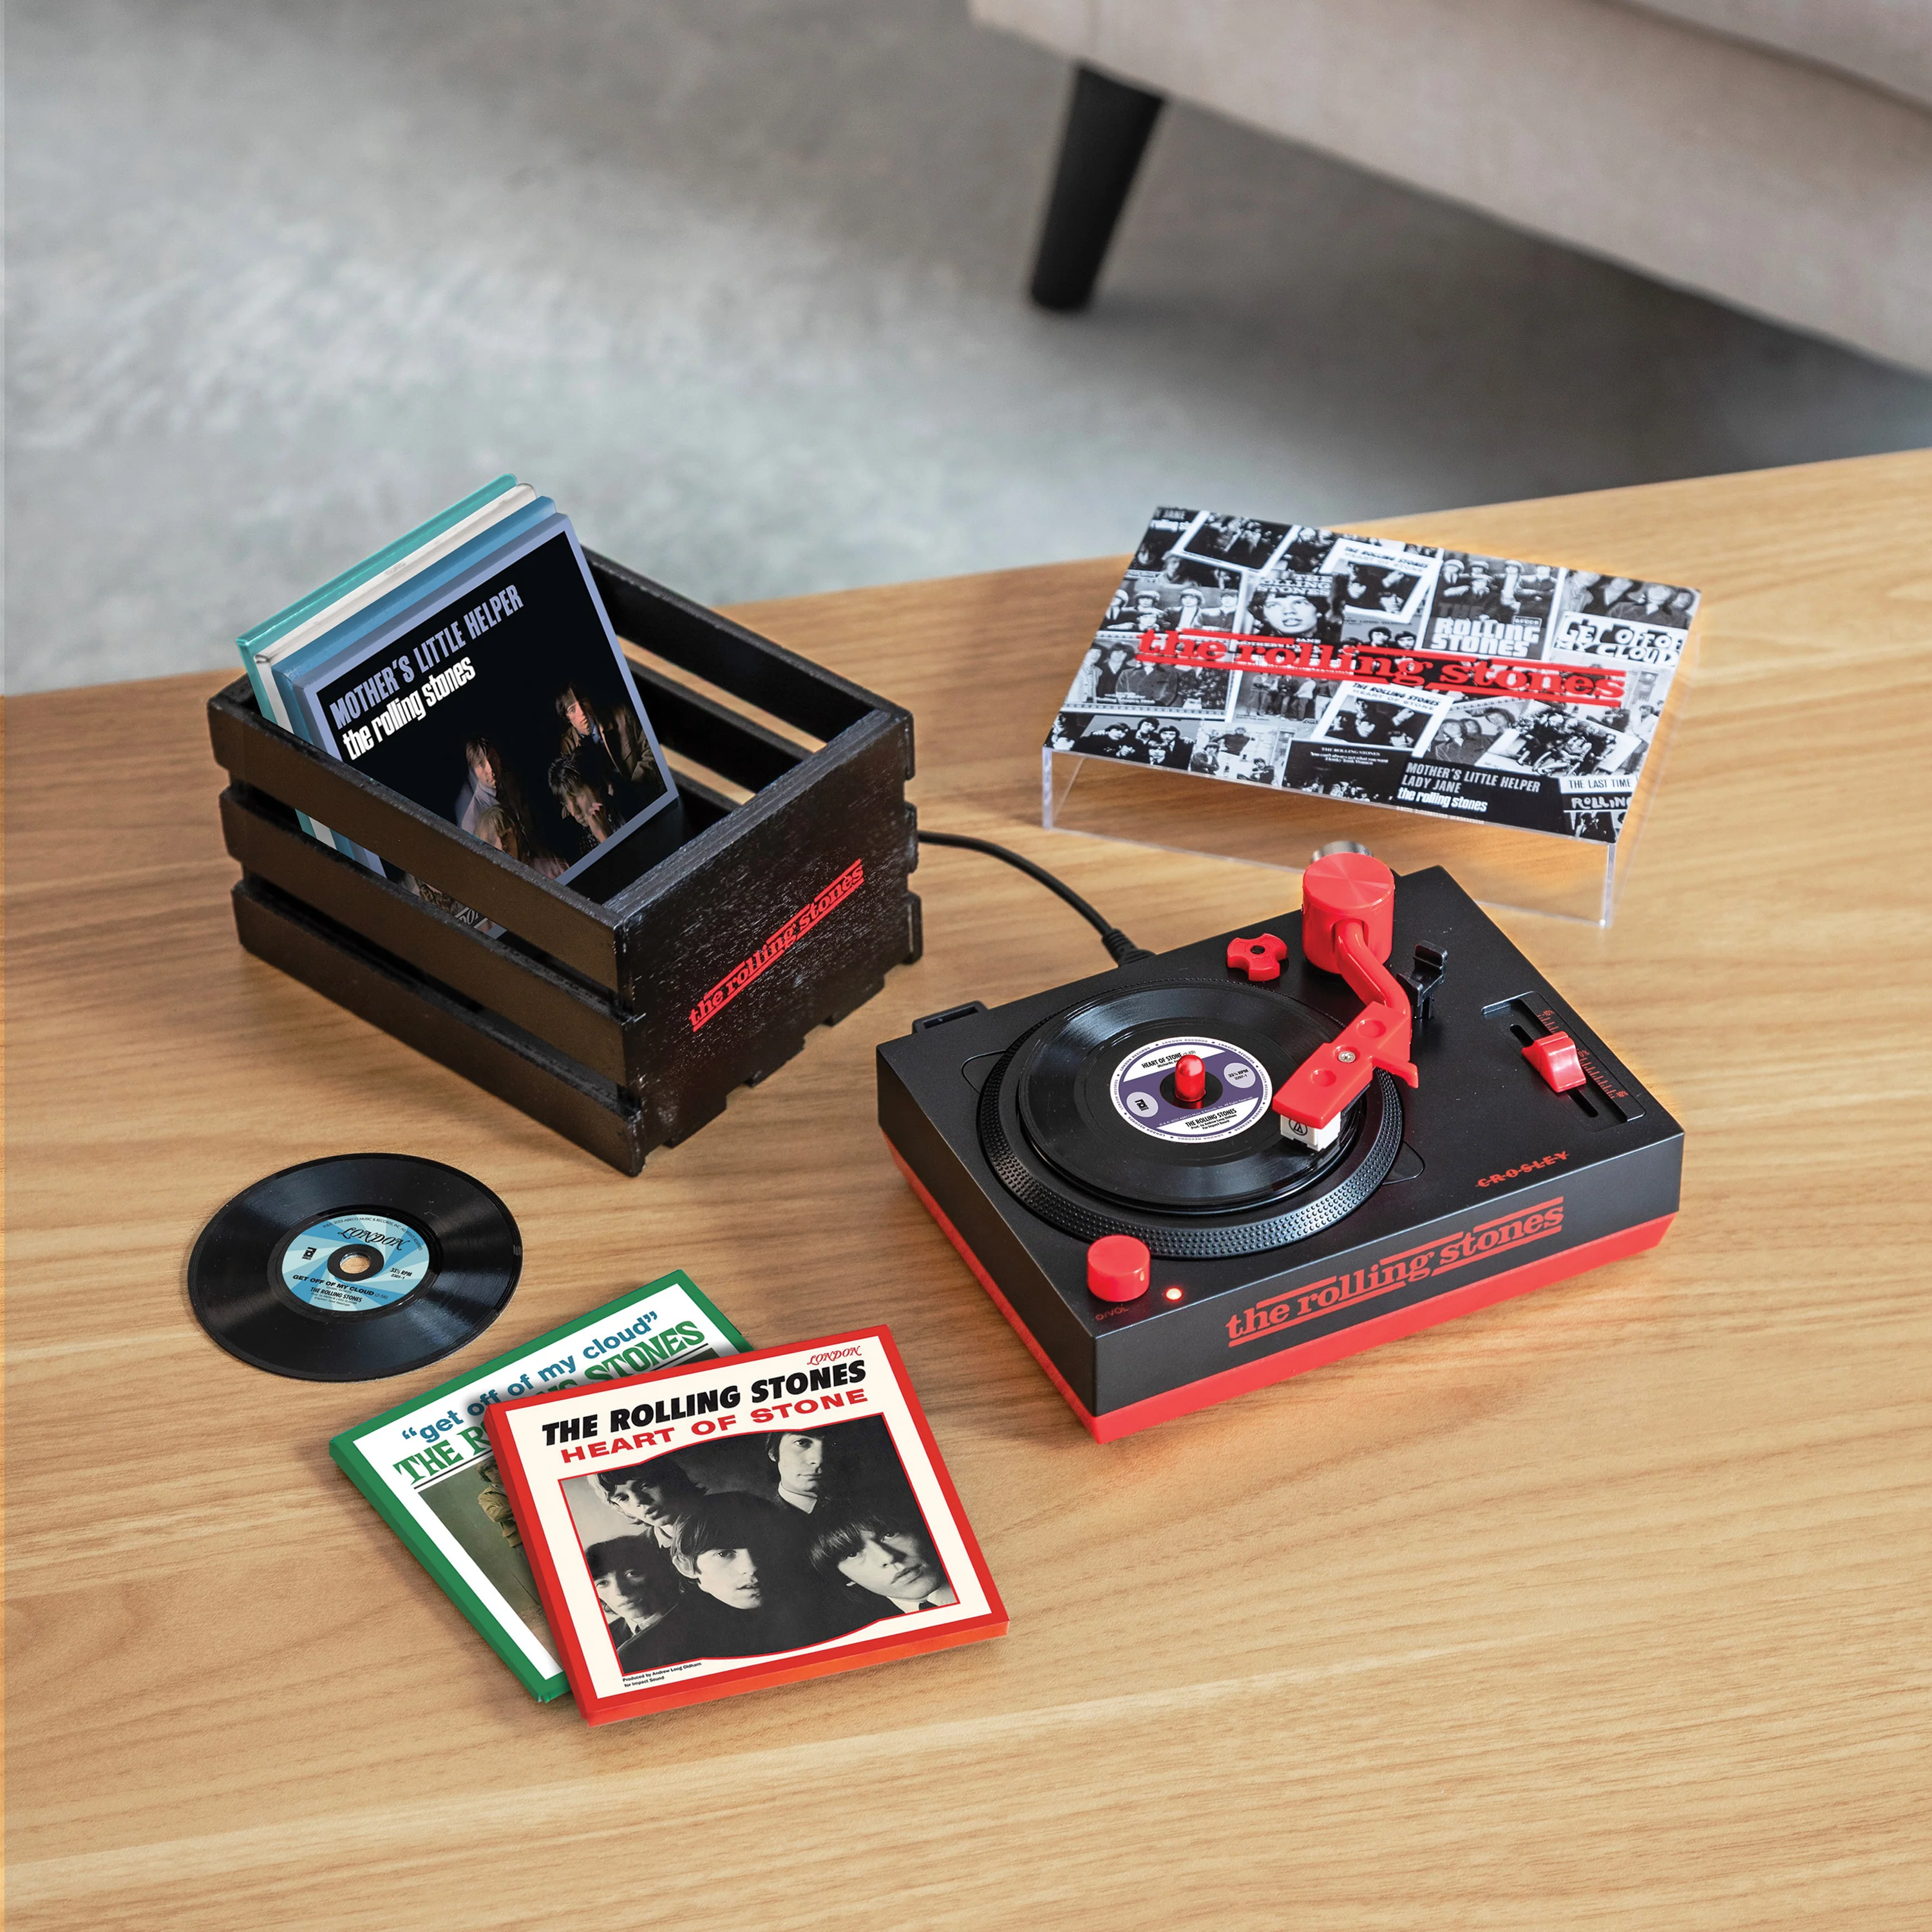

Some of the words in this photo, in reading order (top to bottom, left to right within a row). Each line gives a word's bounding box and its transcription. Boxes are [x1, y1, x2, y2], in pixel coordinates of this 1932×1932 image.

[1434, 617, 1540, 644] ROLLING
[329, 654, 415, 729] MOTHER'S
[413, 621, 466, 674] LITTLE
[464, 585, 524, 639] HELPER
[1430, 633, 1530, 658] STONES
[1596, 644, 1679, 666] CLOUD
[1137, 629, 1226, 660] the
[1236, 643, 1433, 685] rolling
[1440, 659, 1625, 698] stones
[1353, 689, 1382, 699] HEART
[1404, 700, 1433, 710] STONE
[1370, 687, 1406, 698] ROLLING
[1408, 695, 1441, 706] STONES
[343, 728, 374, 761] the
[377, 691, 426, 746] rolling
[425, 657, 475, 708] stones
[1401, 775, 1432, 789] LADY
[1432, 780, 1461, 793] JANE
[1406, 762, 1462, 781] MOTHER'S
[1464, 771, 1499, 786] LITTLE
[1500, 776, 1540, 793] HELPER
[1569, 779, 1585, 789] THE
[1588, 779, 1607, 788] LAST
[1611, 778, 1631, 788] TIME
[1397, 787, 1416, 801] the
[1416, 791, 1450, 808] rolling
[1451, 796, 1488, 812] stones
[689, 989, 723, 1026] the
[726, 923, 796, 995] rolling
[799, 866, 864, 931] stones
[1120, 1058, 1132, 1071] LONDON
[1132, 1046, 1150, 1059] RECORDS
[1142, 1060, 1159, 1068] HEART
[1218, 1043, 1237, 1052] LONDON
[1238, 1051, 1255, 1064] RECORDS
[1128, 1116, 1145, 1129] RECORDS
[1196, 1114, 1217, 1124] ROLLING
[1217, 1108, 1236, 1118] STONES
[1252, 1106, 1264, 1119] LONDON
[1146, 1128, 1165, 1137] LONDON
[1234, 1120, 1253, 1132] RECORDS
[1475, 1151, 1569, 1188] CROSLEY
[337, 1227, 410, 1251] LONDON
[1226, 1301, 1289, 1340] the
[1298, 1251, 1434, 1316] rolling
[1440, 1206, 1564, 1264] stones
[321, 1289, 343, 1298] ROLLING
[343, 1293, 363, 1302] STONES
[350, 1287, 374, 1296] CLOUD
[807, 1345, 862, 1365] LONDON
[468, 1389, 501, 1416] off
[507, 1374, 534, 1396] of
[537, 1355, 576, 1382] my
[393, 1439, 464, 1485] THE
[584, 1321, 705, 1381] STONES
[542, 1414, 598, 1446] THE
[611, 1385, 741, 1432] ROLLING
[752, 1360, 866, 1403] STONES
[560, 1428, 676, 1463] HEART
[691, 1414, 737, 1436] OF
[752, 1388, 868, 1423] STONE
